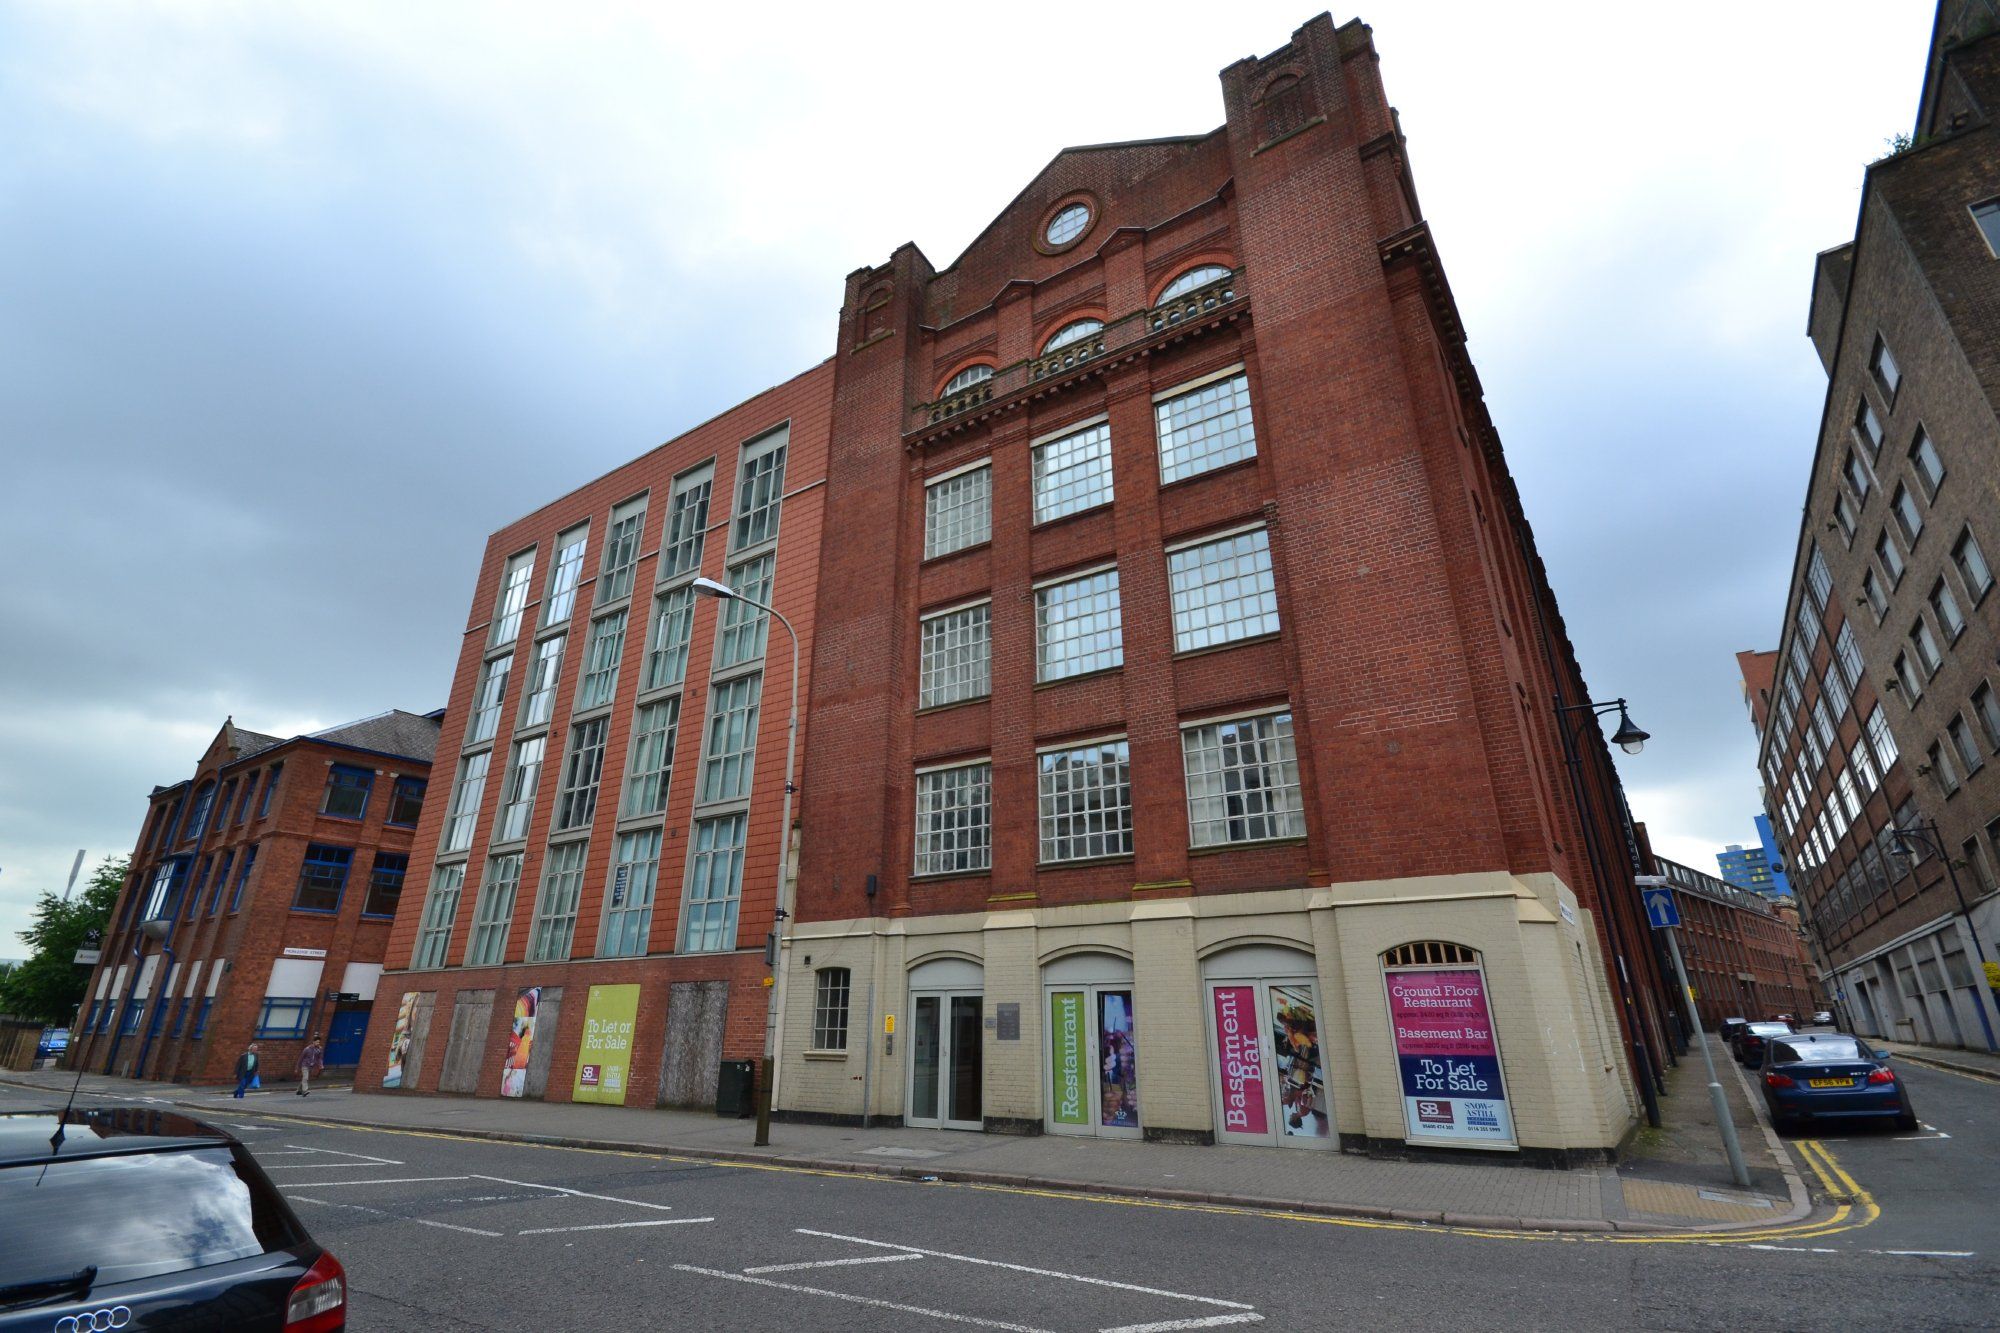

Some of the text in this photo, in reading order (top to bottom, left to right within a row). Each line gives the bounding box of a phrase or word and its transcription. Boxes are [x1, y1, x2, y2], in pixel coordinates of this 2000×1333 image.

[1392, 985, 1479, 997] Ground Floor
[1402, 997, 1473, 1008] Restaurant
[588, 1019, 632, 1034] To Let or
[1397, 1027, 1488, 1039] Basement Bar
[586, 1034, 627, 1050] For Sale
[1061, 997, 1079, 1118] Restaurant
[1218, 992, 1248, 1127] Basement
[1240, 1034, 1262, 1082] Bar
[582, 1066, 594, 1078] SB
[1420, 1059, 1477, 1076] To Let
[1414, 1074, 1488, 1092] For Sale
[1419, 1102, 1439, 1115] SB
[1464, 1102, 1488, 1110] SNOW
[1466, 1109, 1496, 1118] ASTILL
